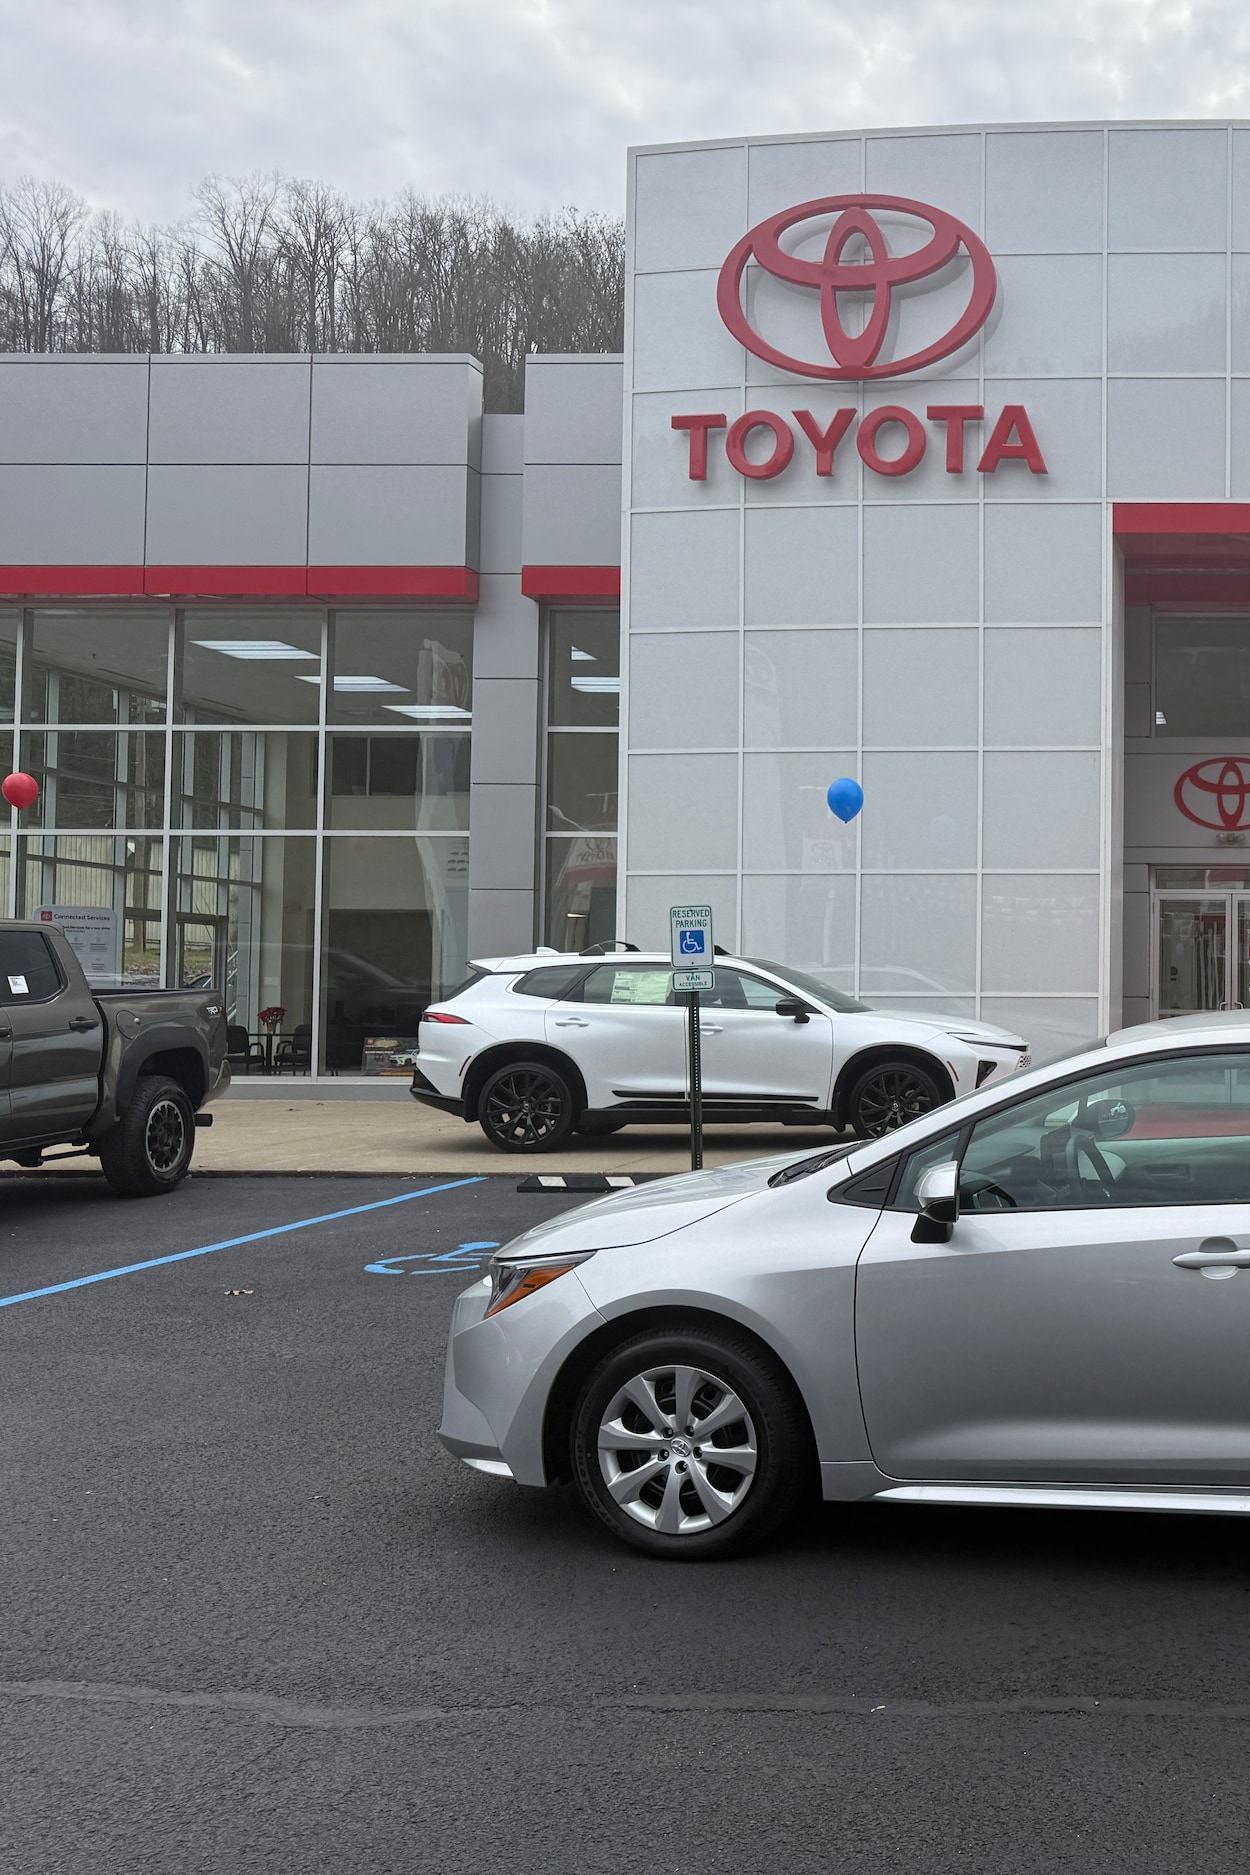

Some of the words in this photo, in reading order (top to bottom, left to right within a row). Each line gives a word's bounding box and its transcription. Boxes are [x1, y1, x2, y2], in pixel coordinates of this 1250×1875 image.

[671, 404, 1048, 481] TOYOTA
[672, 909, 710, 919] RESERVED
[675, 919, 707, 928] PARKING
